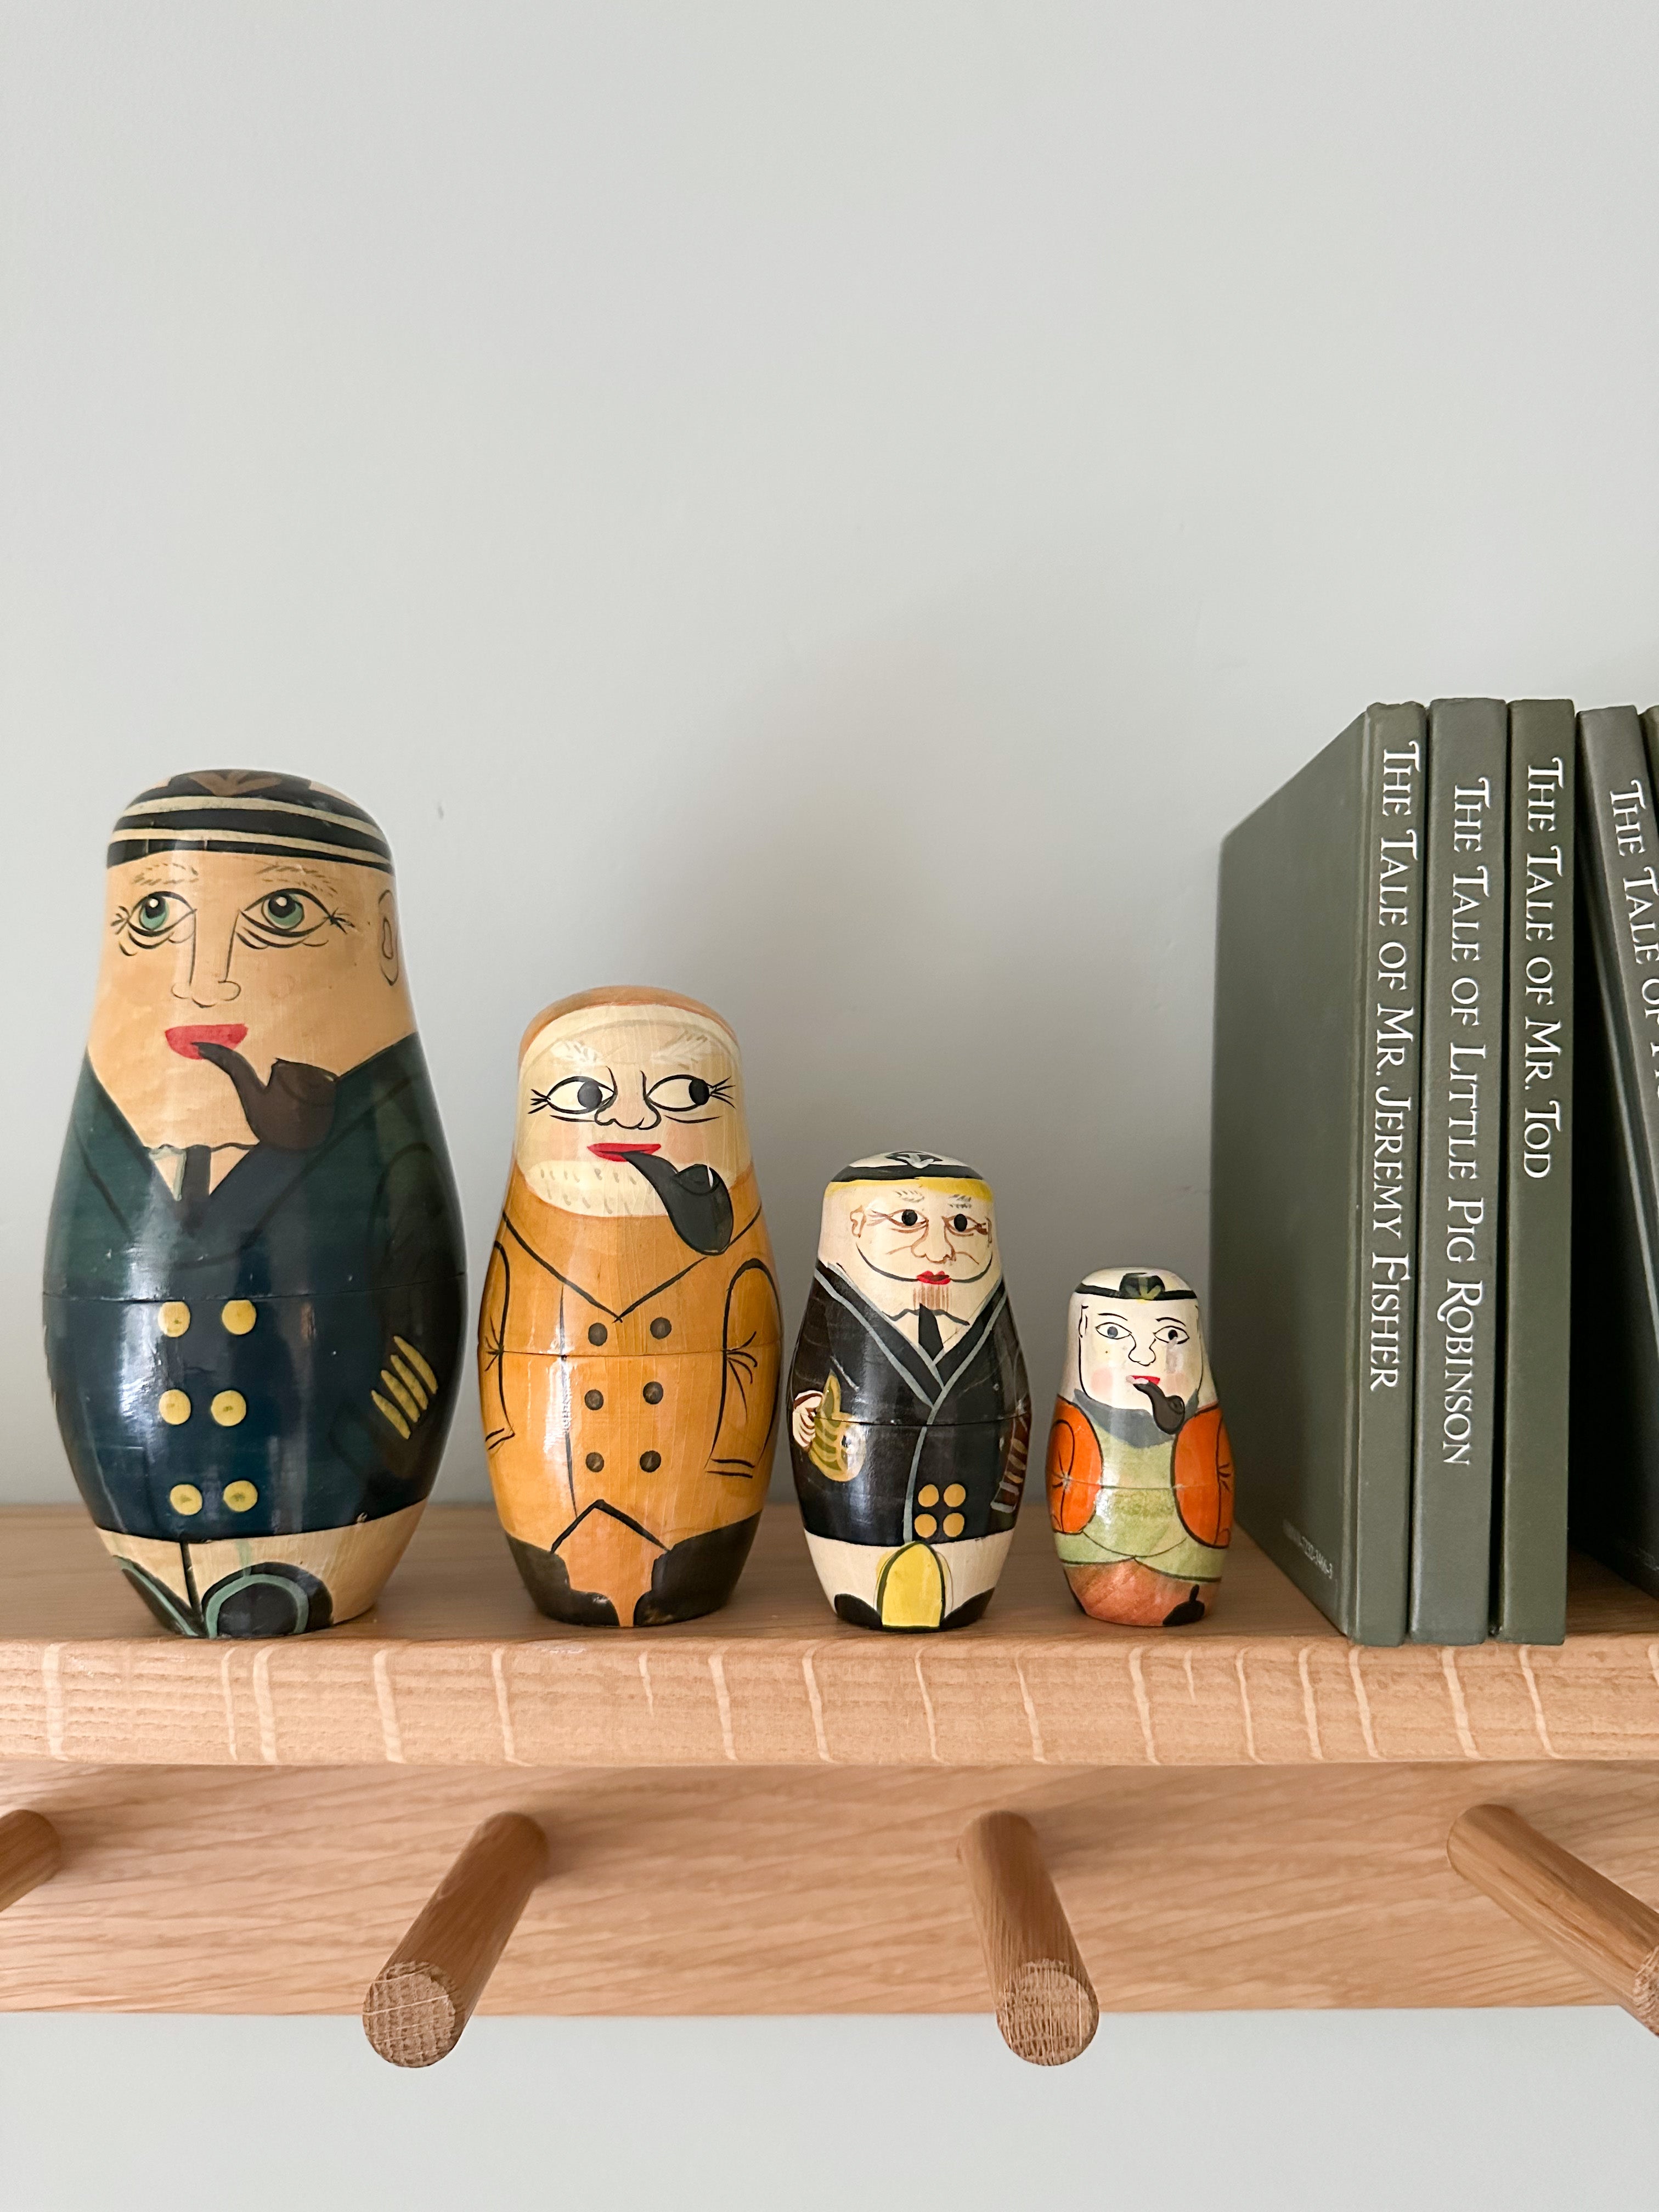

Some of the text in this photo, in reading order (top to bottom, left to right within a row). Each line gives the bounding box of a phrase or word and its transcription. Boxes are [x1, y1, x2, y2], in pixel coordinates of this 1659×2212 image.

[1523, 757, 1564, 1179] THE TALE OF MR. TOD
[1609, 779, 1647, 857] THE
[1622, 866, 1659, 965] TALE
[1369, 740, 1421, 1392] THE TALE OF MR. JEREMY FISHER
[1436, 776, 1491, 1466] THE TALE OF LITTLE PIG ROBINSON
